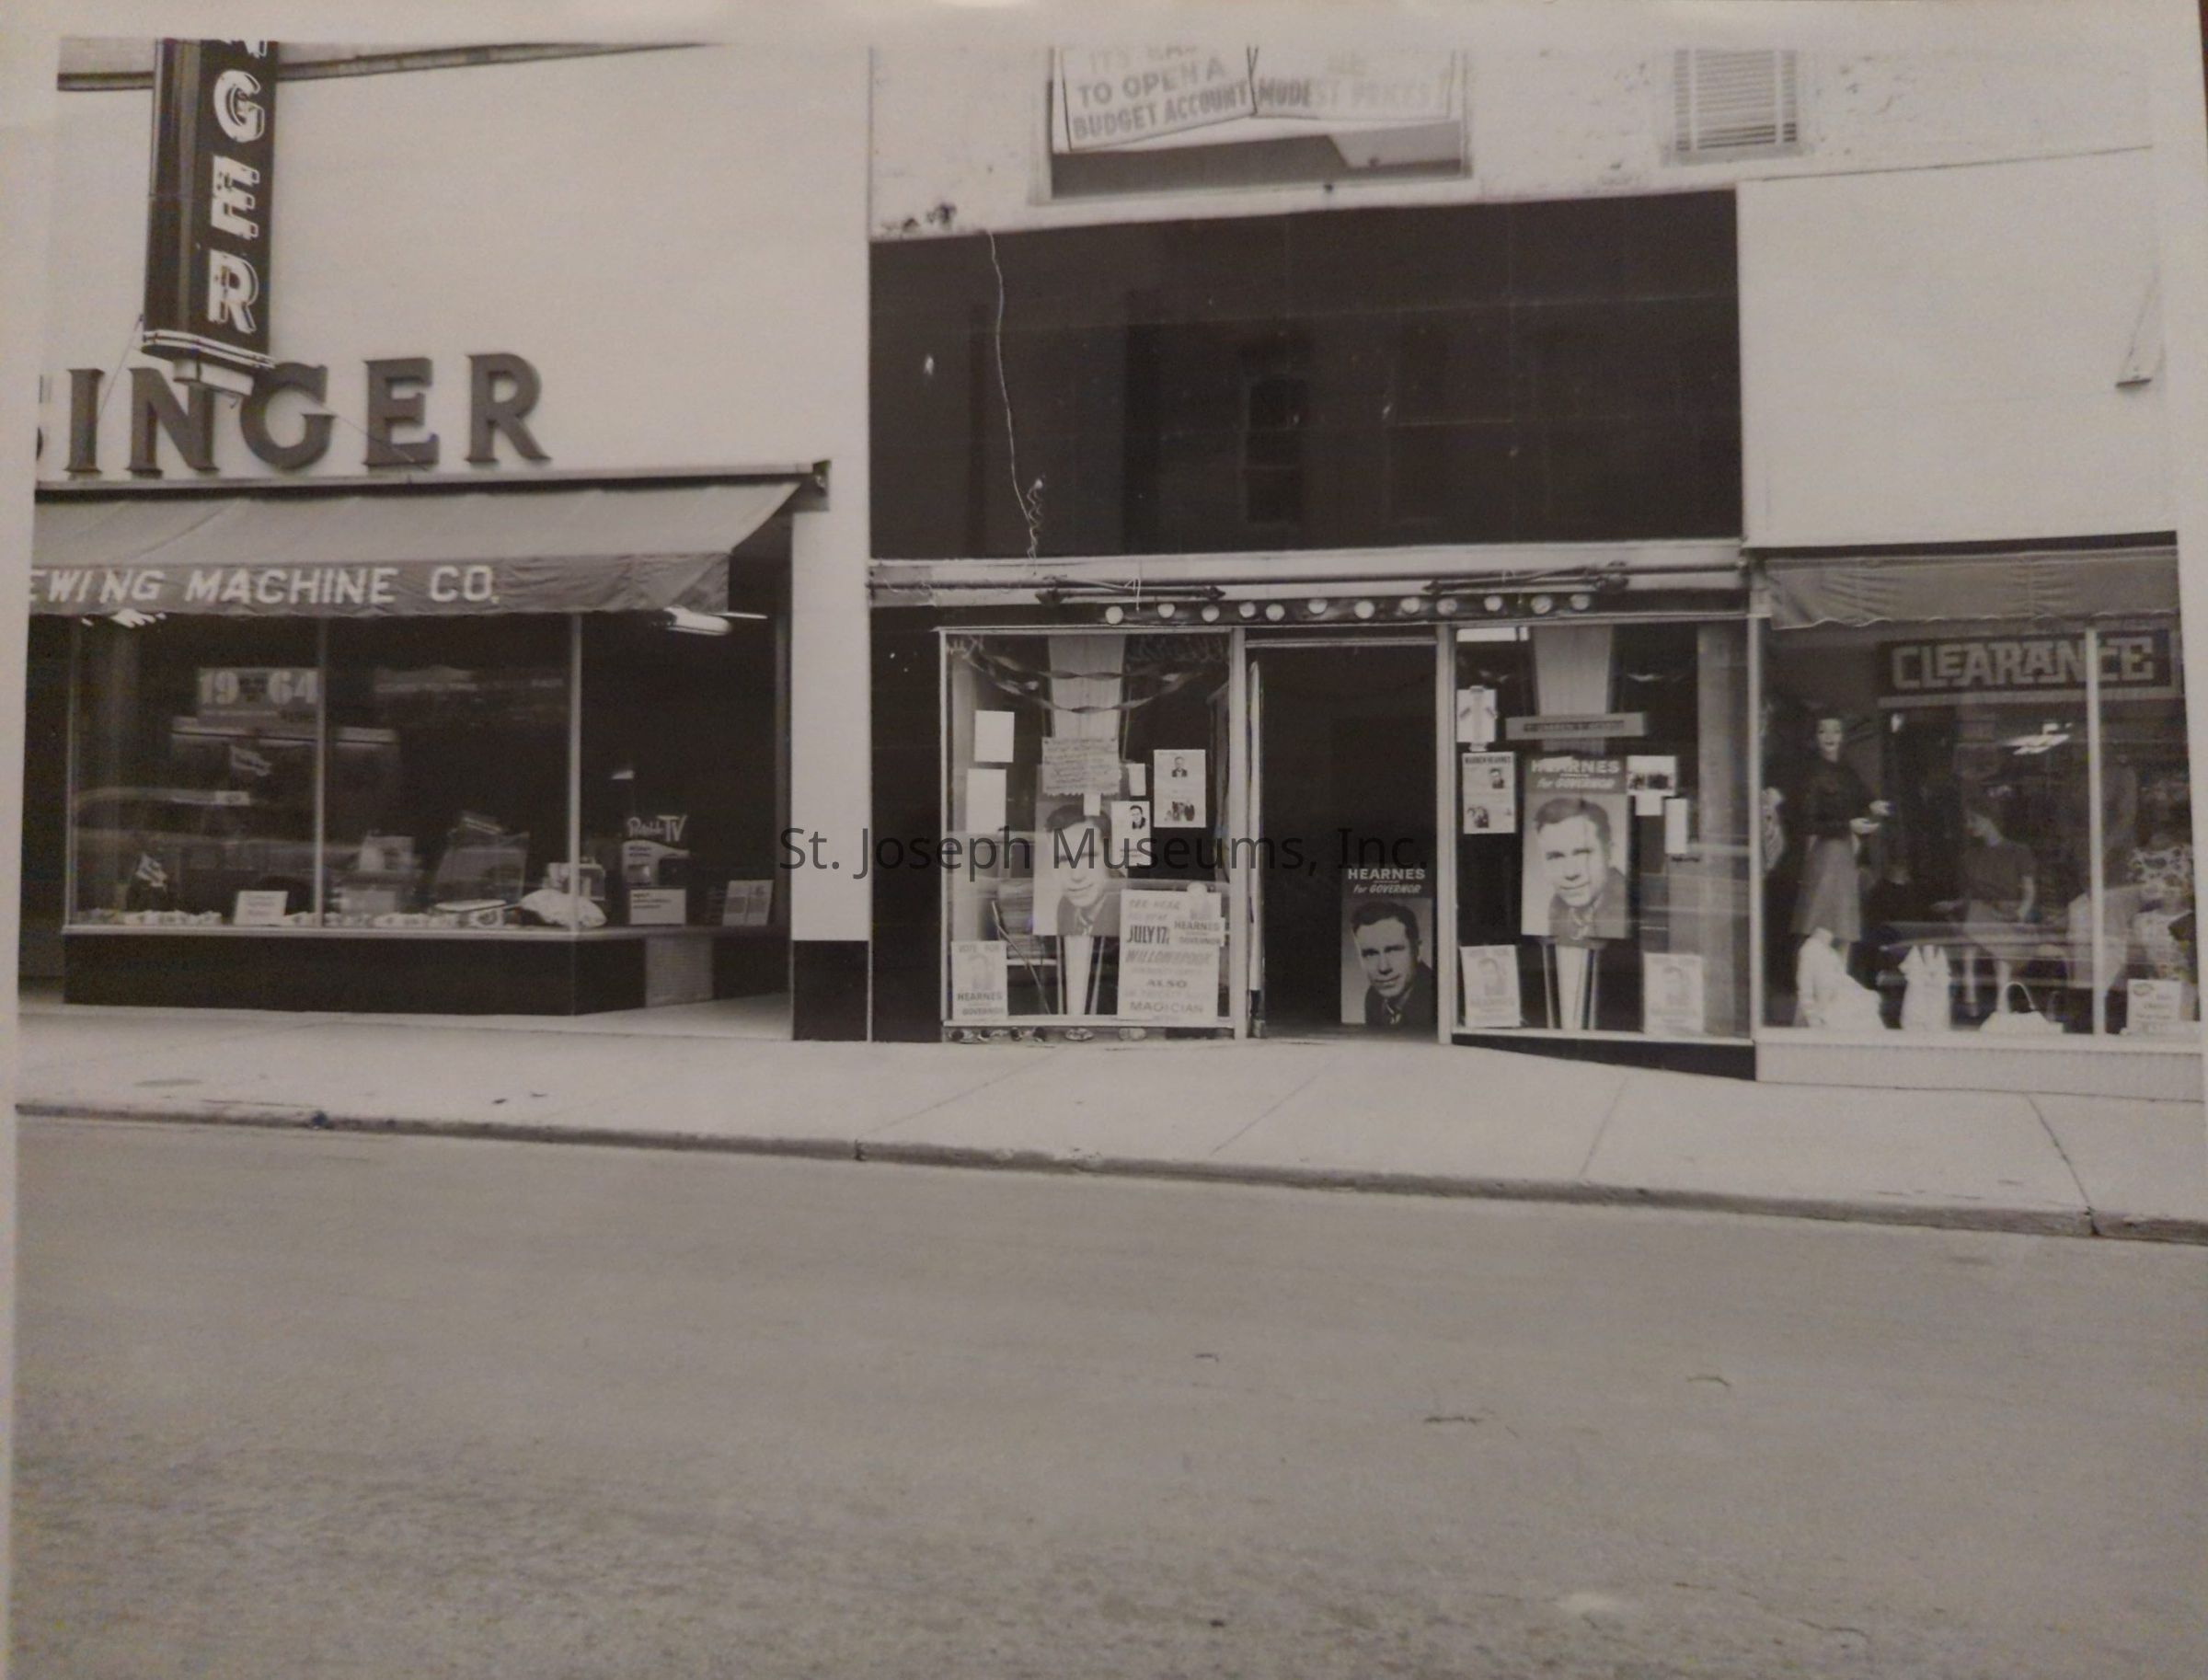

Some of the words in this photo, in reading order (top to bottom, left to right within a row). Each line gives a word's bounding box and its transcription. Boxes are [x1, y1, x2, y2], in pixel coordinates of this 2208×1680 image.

[1076, 82, 1112, 108] TO
[1121, 60, 1199, 98] OPEN
[1206, 56, 1225, 81] A
[1073, 103, 1157, 140] BUDGET
[1164, 79, 1248, 124] ACCOUNT
[207, 40, 268, 334] GER
[37, 353, 552, 477] INGER
[185, 567, 398, 604] MACHINE
[429, 565, 500, 604] CO.
[1892, 636, 2154, 689] CLEARANCE
[657, 815, 688, 842] TV
[1348, 868, 1425, 880] HEARNES
[1352, 883, 1368, 894] for
[1369, 883, 1421, 894] GOVERNOR
[1125, 925, 1156, 944] JULY
[1174, 920, 1220, 931] HEARNES
[957, 992, 1003, 1001] HEARNES
